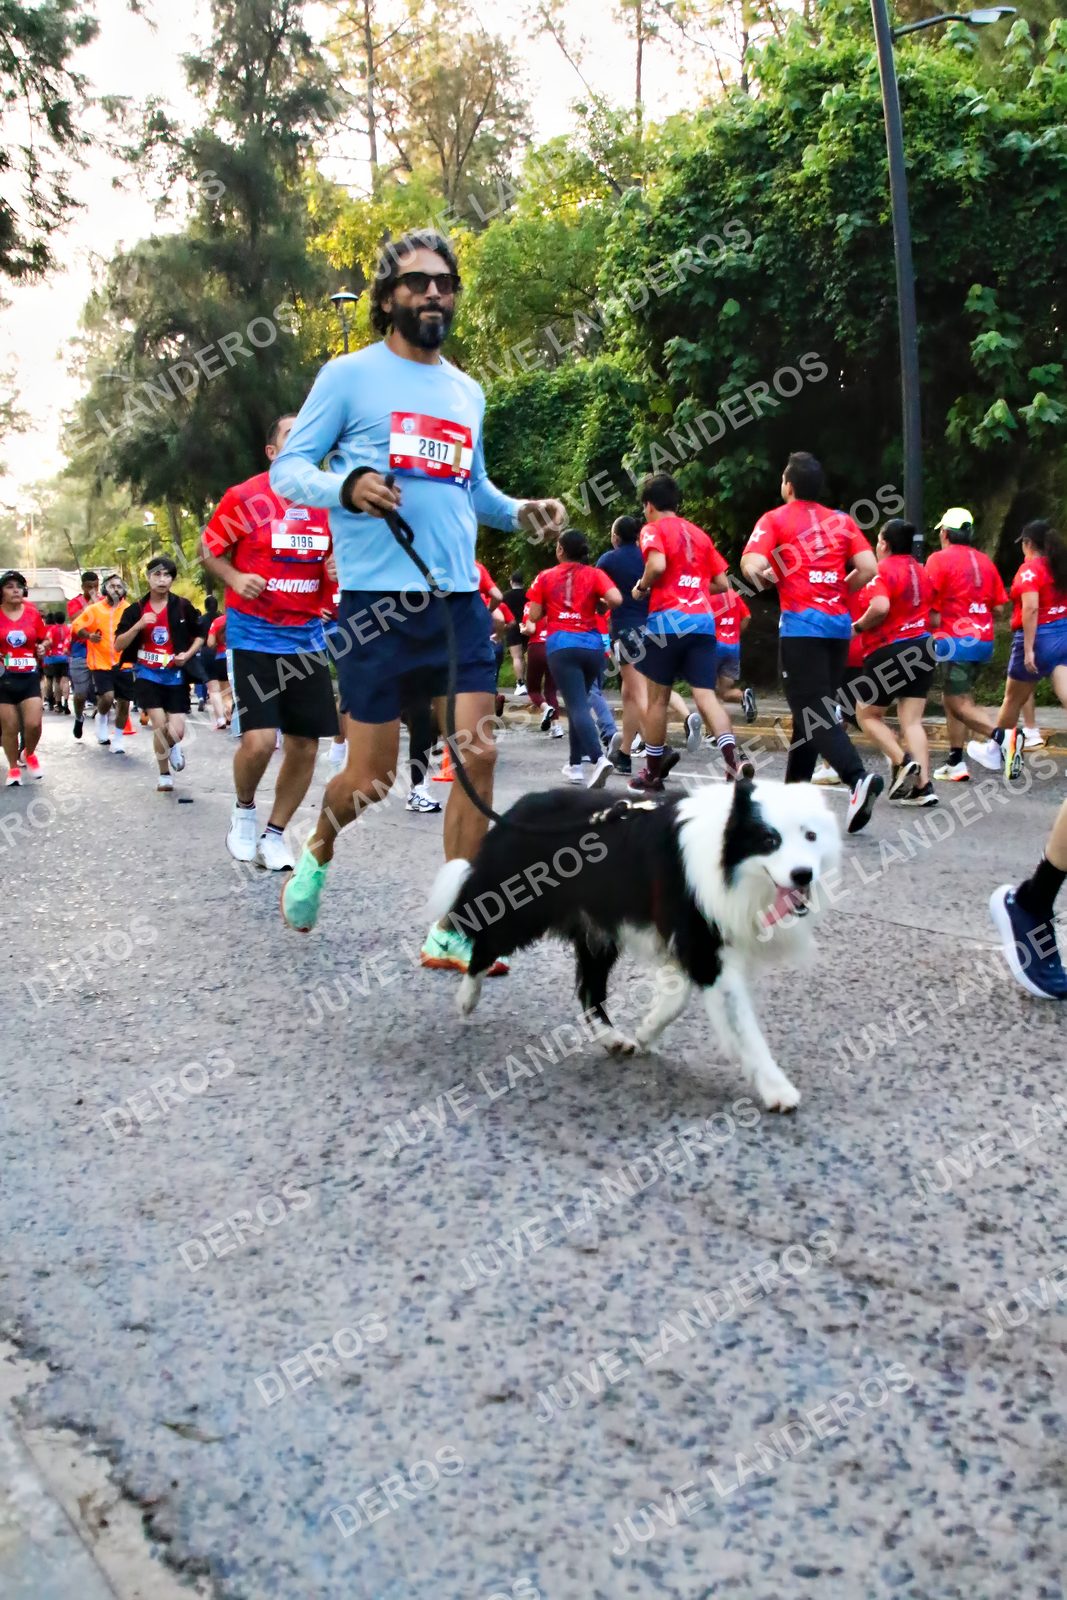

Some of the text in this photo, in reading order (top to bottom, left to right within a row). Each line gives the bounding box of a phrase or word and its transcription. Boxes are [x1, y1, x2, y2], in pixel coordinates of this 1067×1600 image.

[419, 438, 449, 461] 2817
[290, 535, 313, 548] 3196
[266, 577, 320, 593] SANTIAGO
